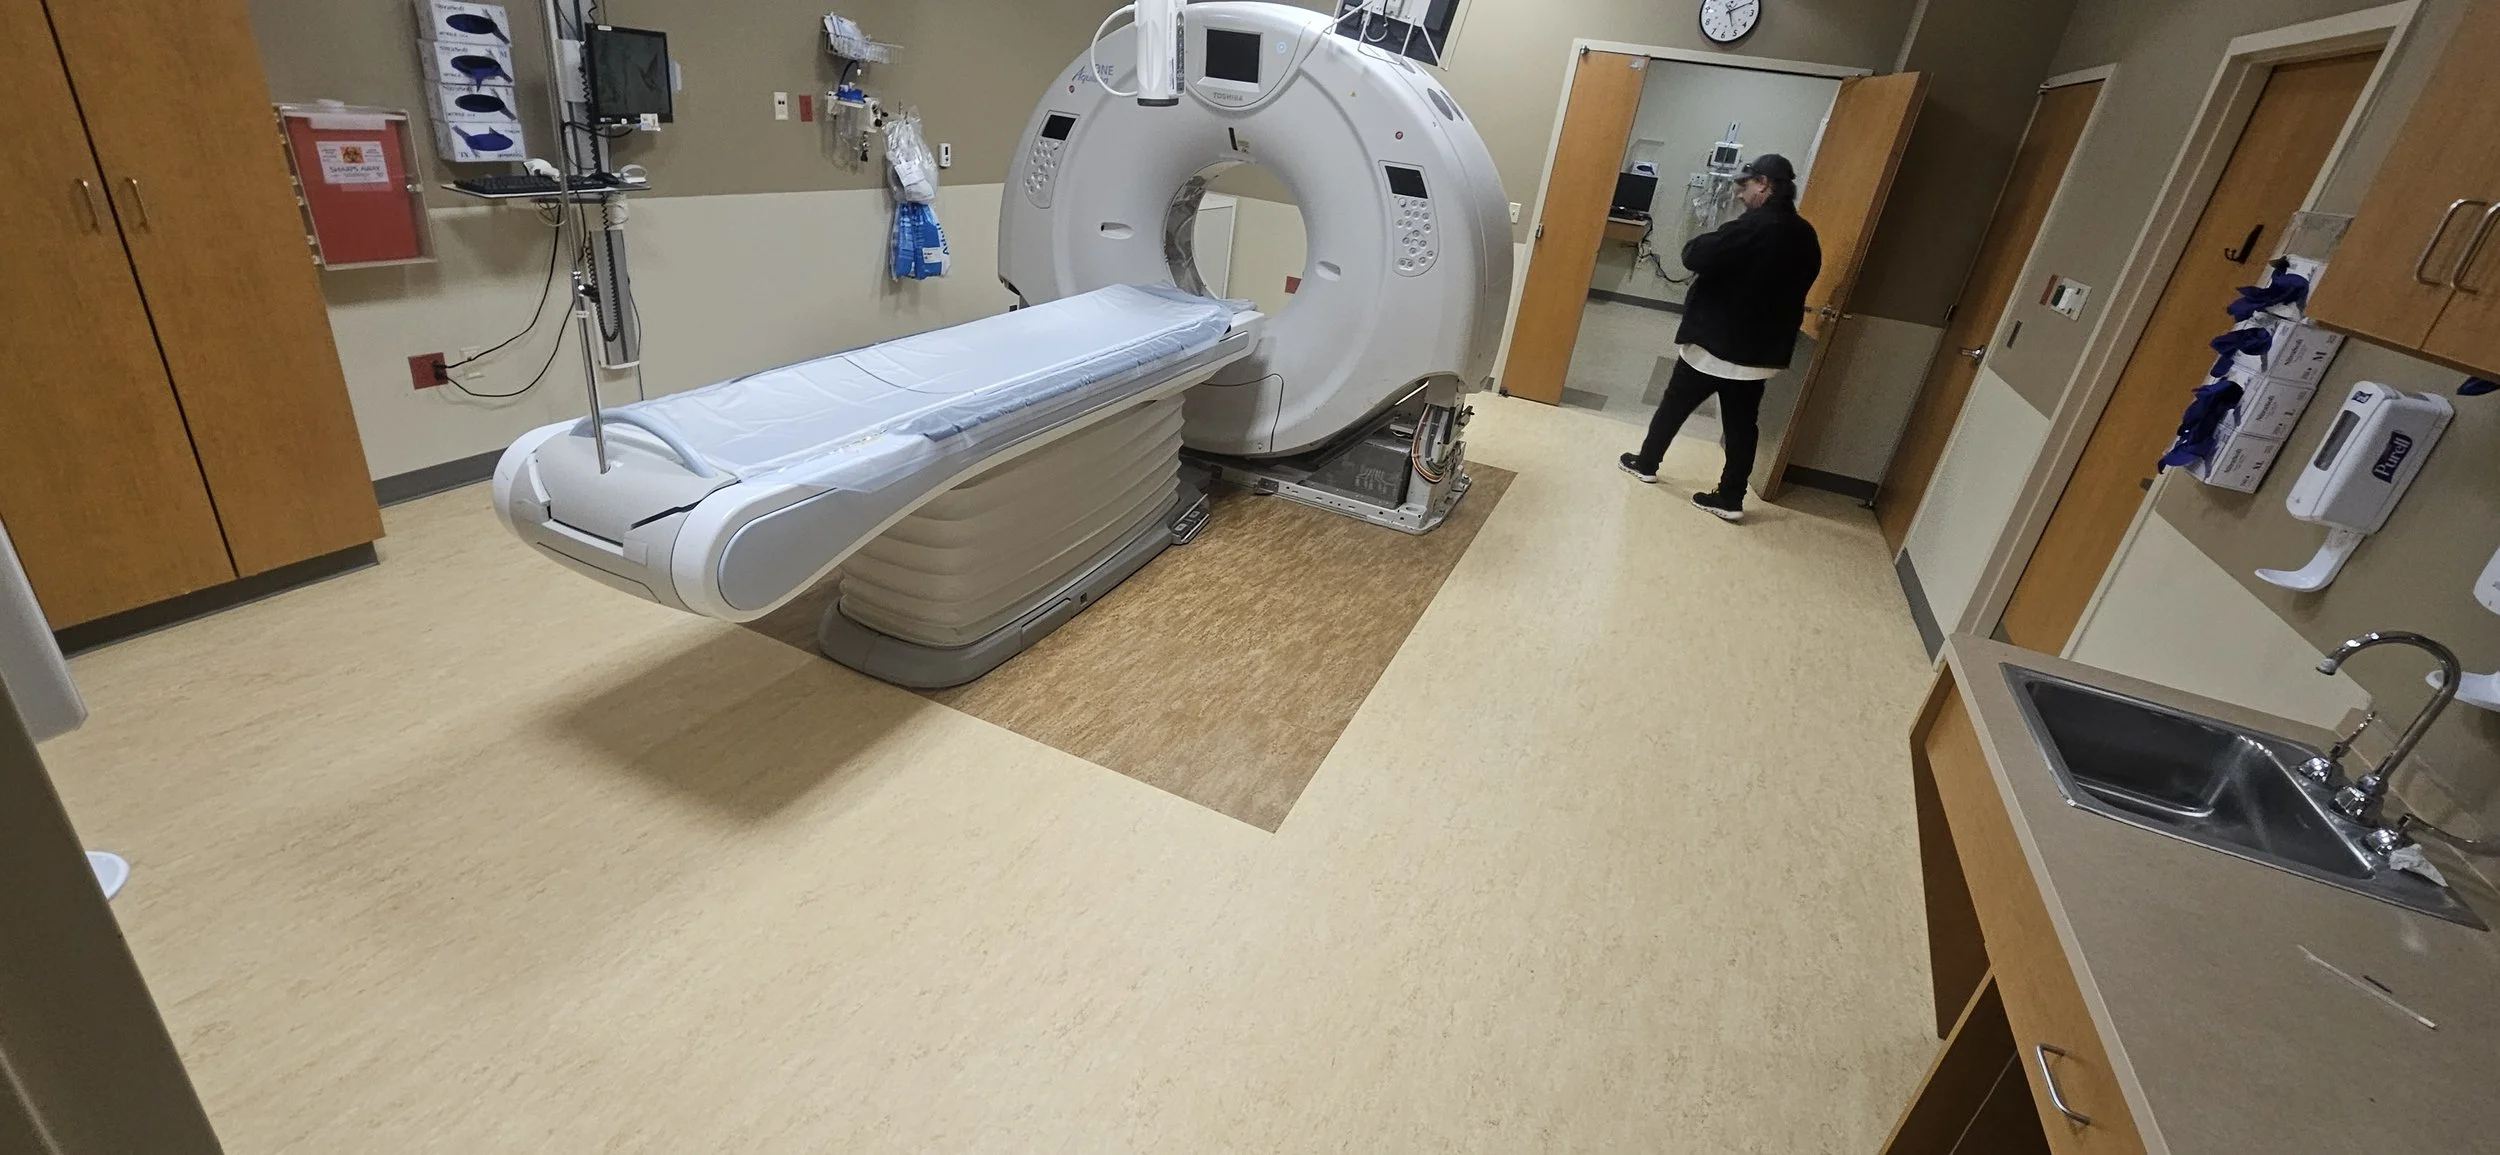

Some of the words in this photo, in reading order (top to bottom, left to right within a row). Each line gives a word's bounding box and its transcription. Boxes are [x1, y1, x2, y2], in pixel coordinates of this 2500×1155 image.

[1749, 9, 1755, 17] 3
[1705, 18, 1711, 26] 8
[1720, 31, 1726, 39] 6
[1213, 92, 1243, 102] TOSHIBA
[2312, 351, 2327, 361] M
[2374, 436, 2411, 477] Purell
